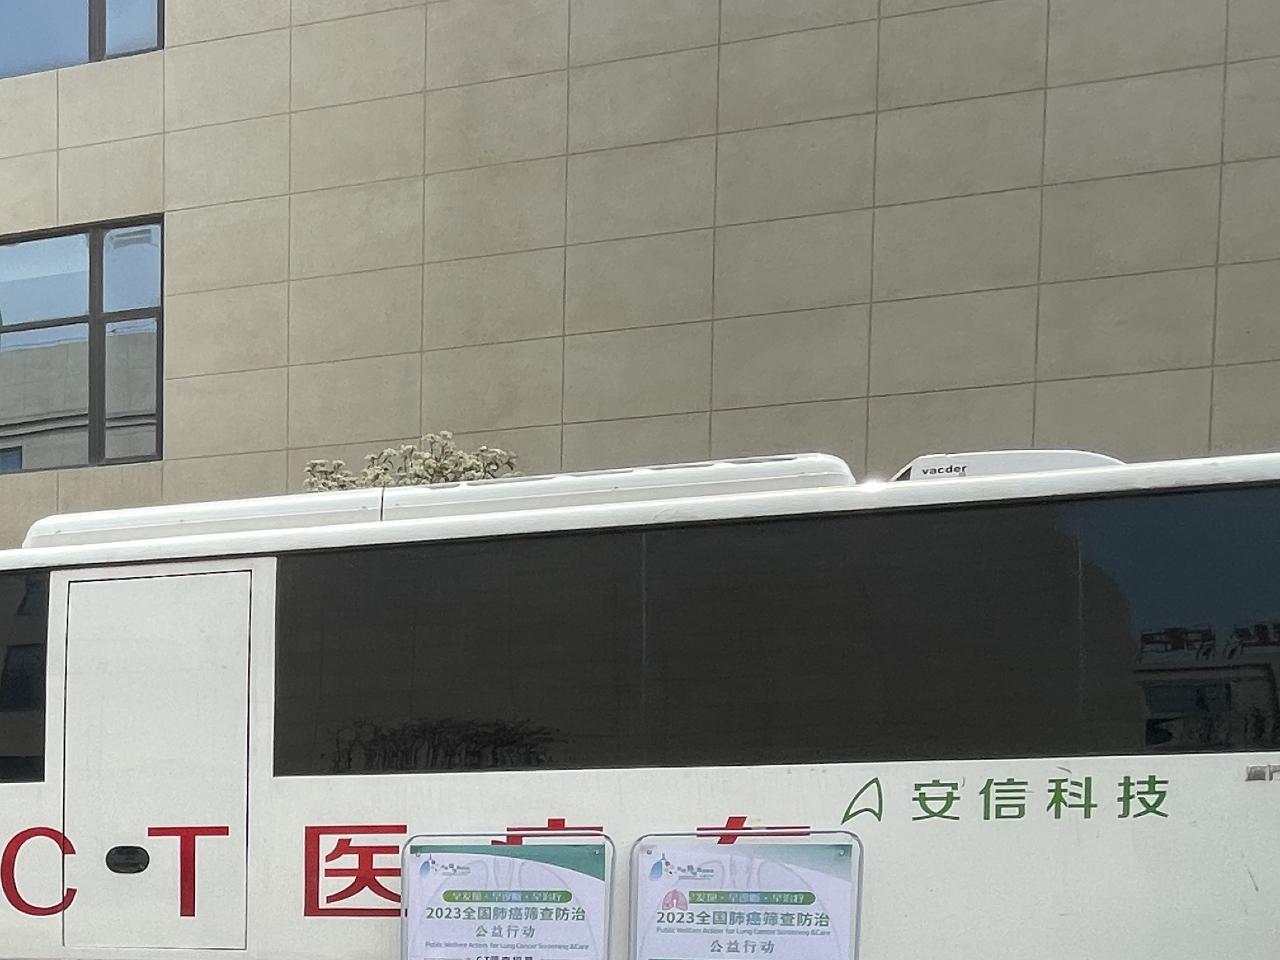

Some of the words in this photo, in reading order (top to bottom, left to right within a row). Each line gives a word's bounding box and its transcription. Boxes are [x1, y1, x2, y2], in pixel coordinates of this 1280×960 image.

[922, 465, 968, 475] vacder
[912, 775, 1169, 821] 安信科技
[426, 906, 586, 921] 2023全国肺癌筛查防治
[656, 910, 831, 927] 2023全国肺癌筛查防治
[475, 924, 536, 938] 公益行动
[710, 939, 776, 954] 公益行动
